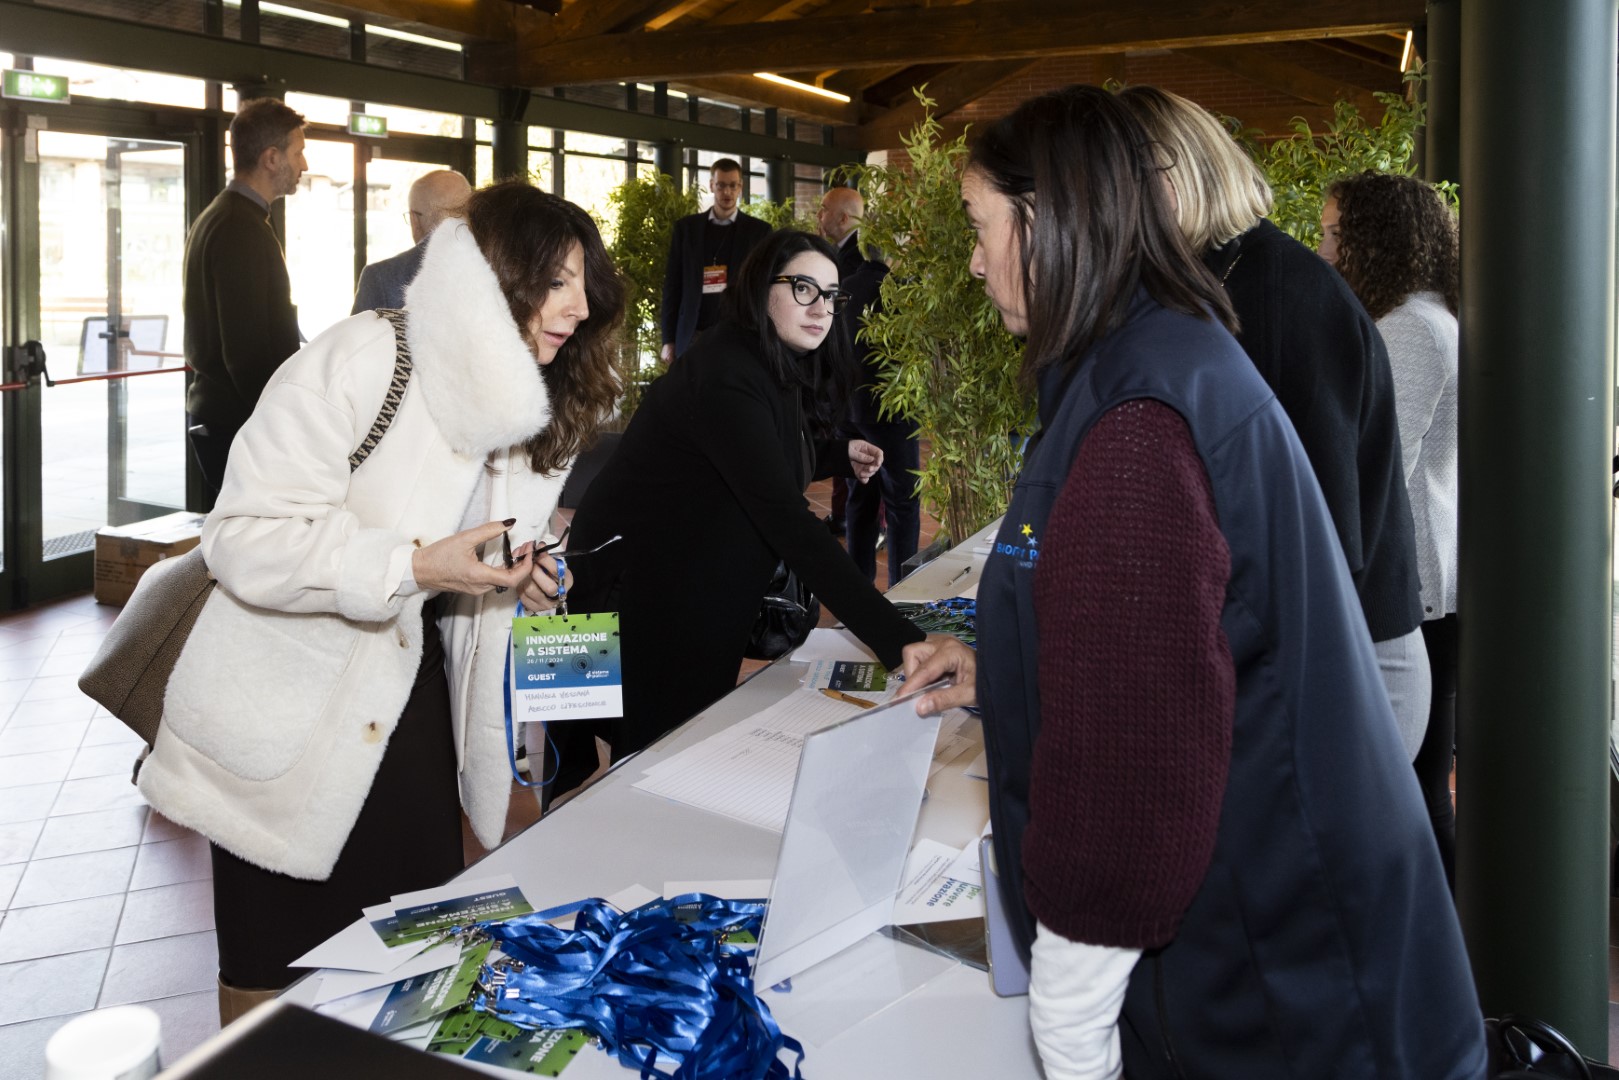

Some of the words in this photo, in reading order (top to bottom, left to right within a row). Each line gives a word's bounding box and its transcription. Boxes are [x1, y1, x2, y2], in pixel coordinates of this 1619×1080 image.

[526, 632, 607, 645] INNOVAZIONE
[527, 647, 535, 656] A
[538, 645, 588, 656] SISTEMA
[527, 673, 556, 681] GUEST
